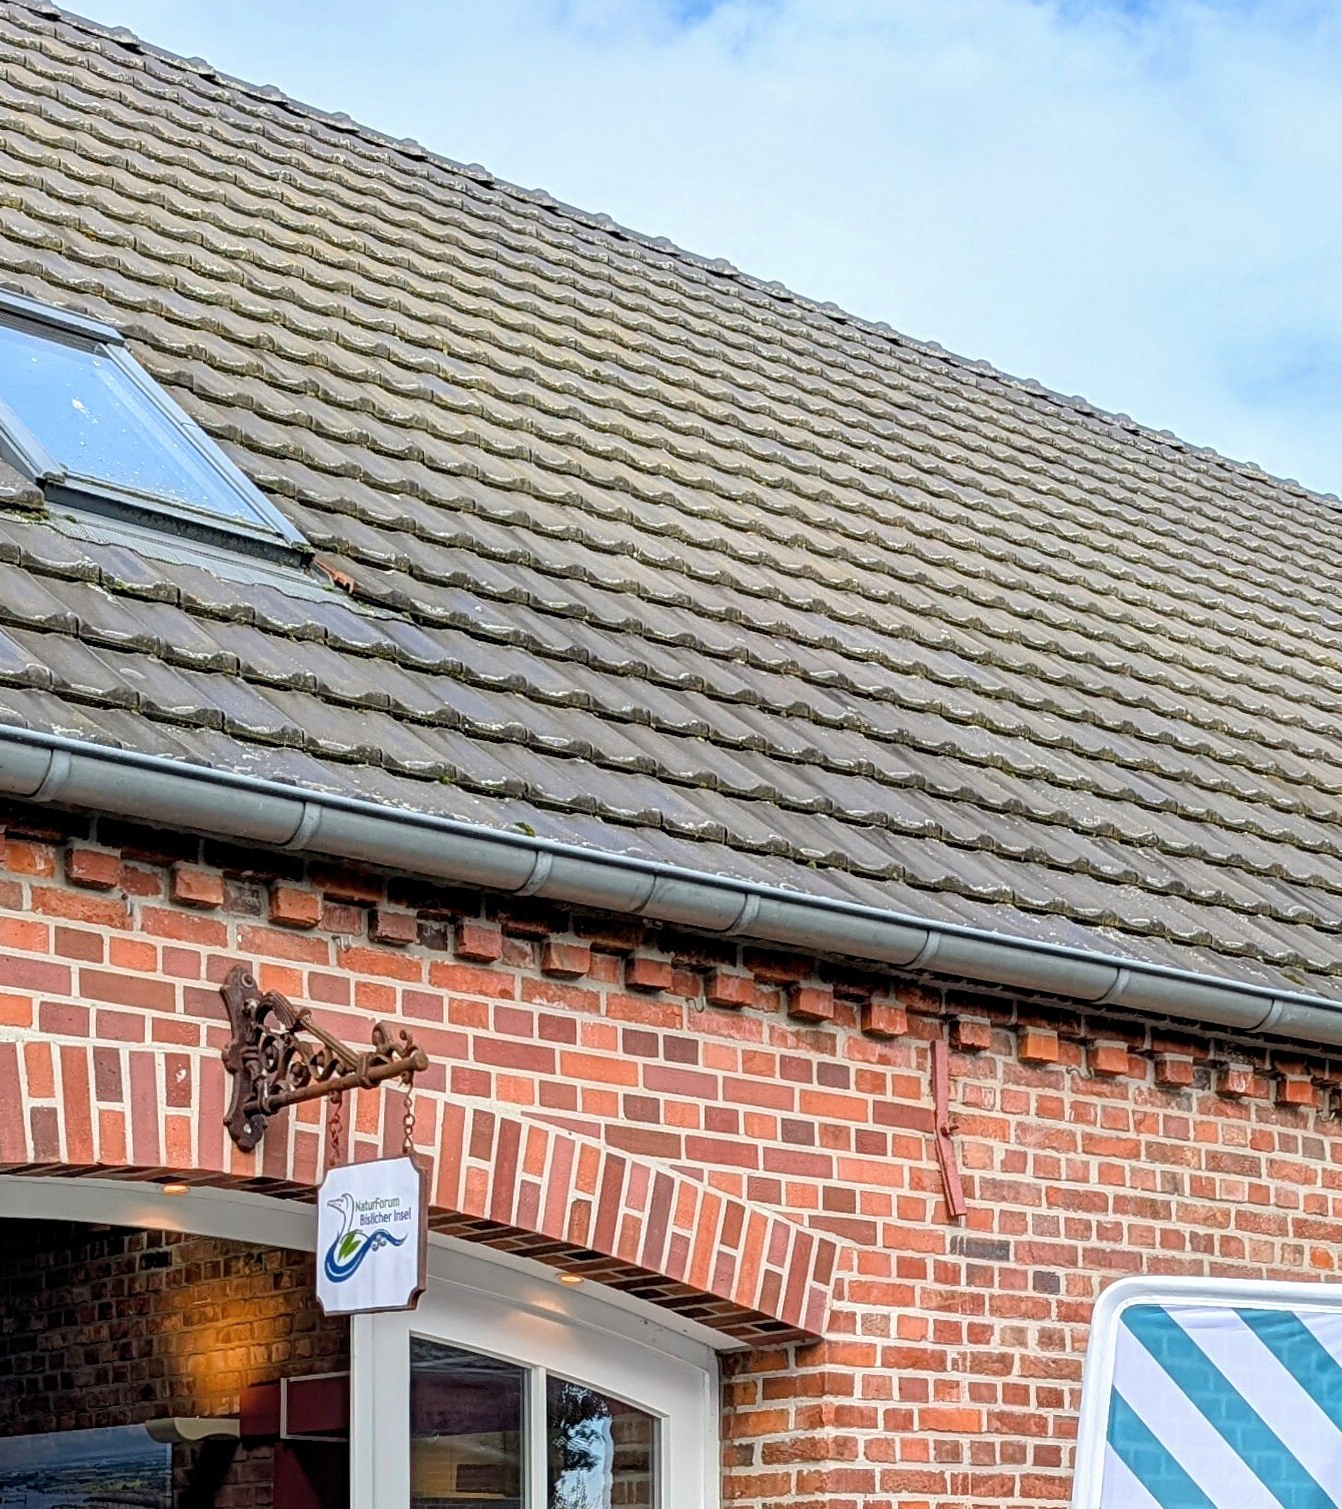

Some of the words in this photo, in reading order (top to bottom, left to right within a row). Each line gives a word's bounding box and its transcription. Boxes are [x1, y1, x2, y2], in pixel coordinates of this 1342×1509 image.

[355, 1197, 400, 1211] NaturForum
[359, 1213, 392, 1226] Bislicher
[393, 1207, 412, 1221] Insel
